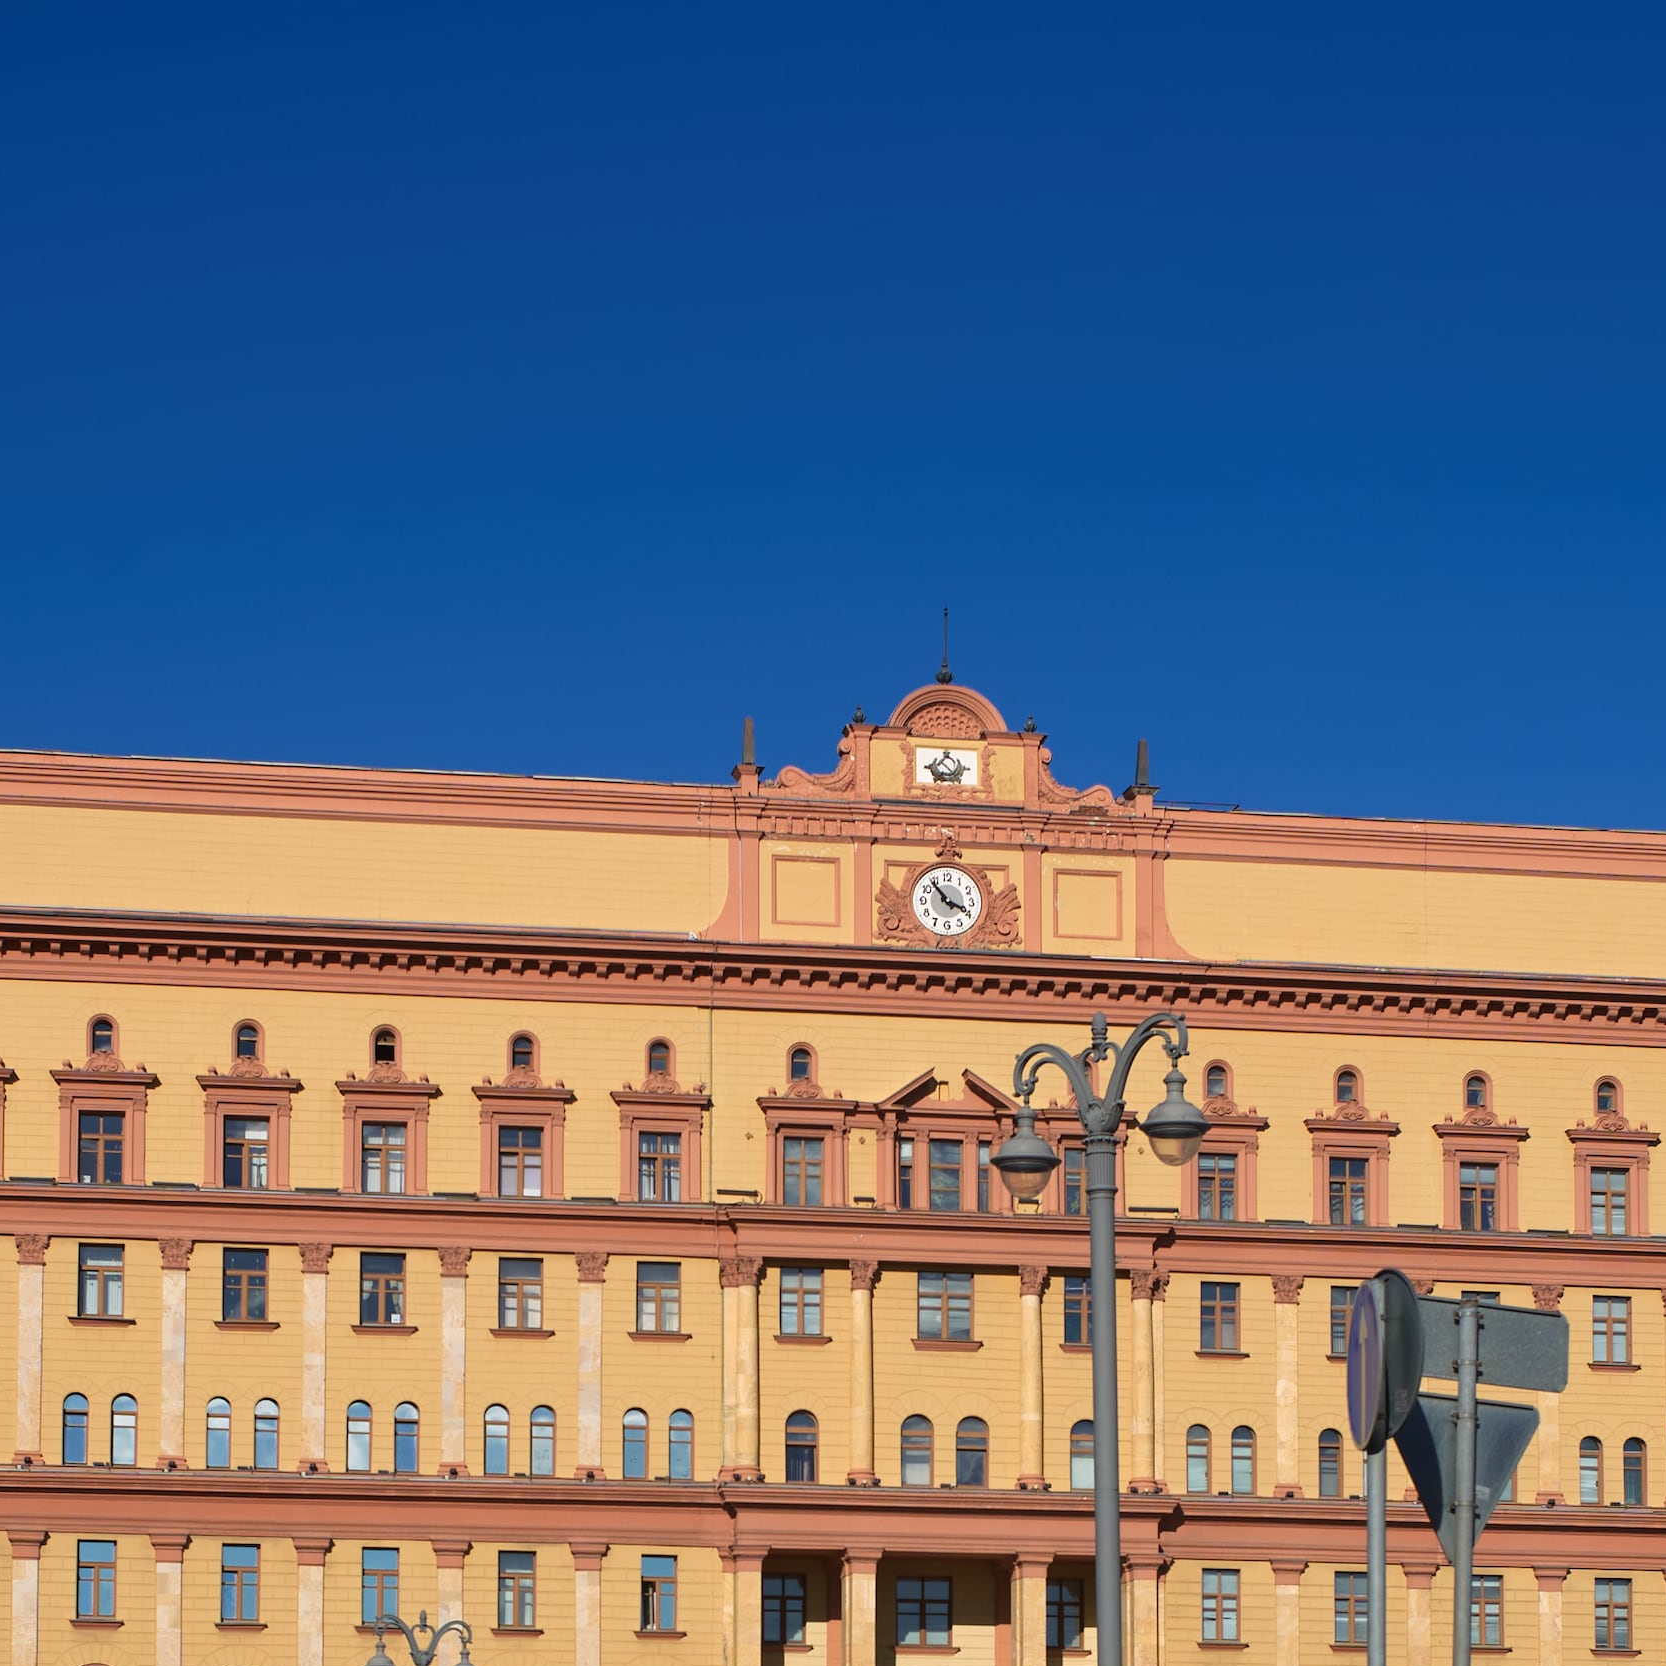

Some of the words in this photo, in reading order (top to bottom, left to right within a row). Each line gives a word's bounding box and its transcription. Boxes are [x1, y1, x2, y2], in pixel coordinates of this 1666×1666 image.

[943, 872, 952, 882] 12
[957, 877, 961, 886] 1
[922, 885, 932, 894] 10
[965, 885, 972, 895] 2
[919, 896, 927, 905] 9
[968, 897, 975, 907] 3
[923, 908, 930, 917] 8
[932, 917, 938, 927] 7
[943, 920, 951, 930] 6
[956, 919, 963, 927] 5
